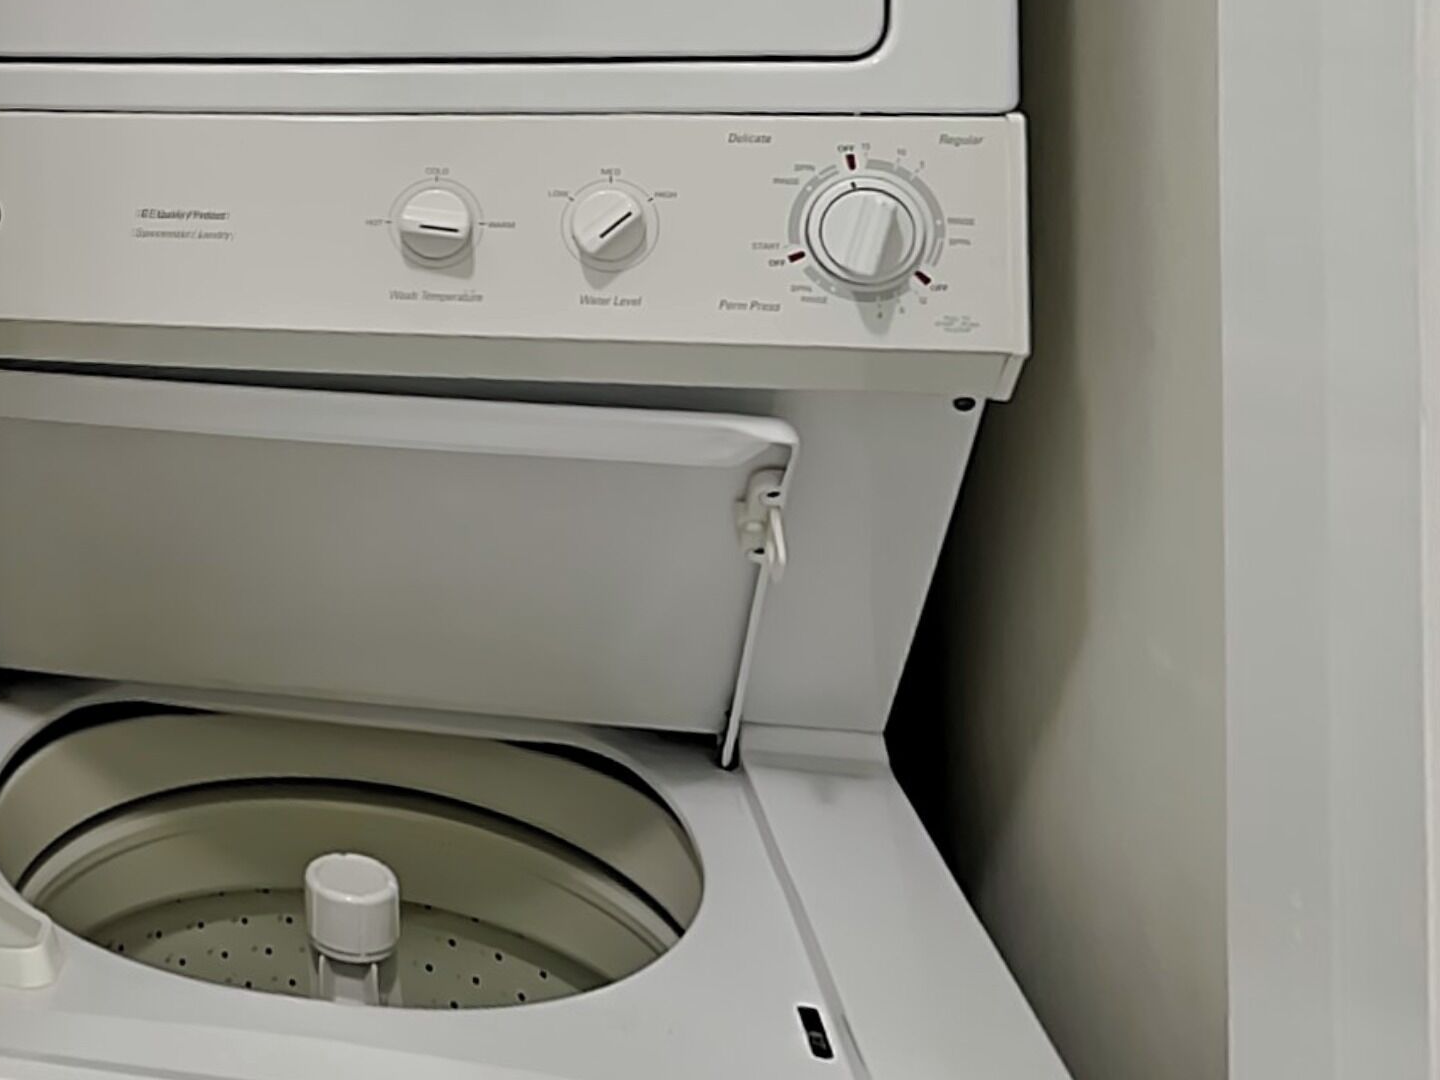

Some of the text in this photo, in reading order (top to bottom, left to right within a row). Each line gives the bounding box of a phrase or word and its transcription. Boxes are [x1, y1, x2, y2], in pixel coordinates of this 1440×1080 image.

[728, 133, 772, 144] Delicate
[939, 134, 984, 147] Regular
[837, 144, 855, 153] OFF
[768, 258, 786, 267] OFF
[389, 290, 483, 302] Wash Temperature
[579, 294, 642, 307] Water Level
[719, 299, 781, 312] Perm Press
